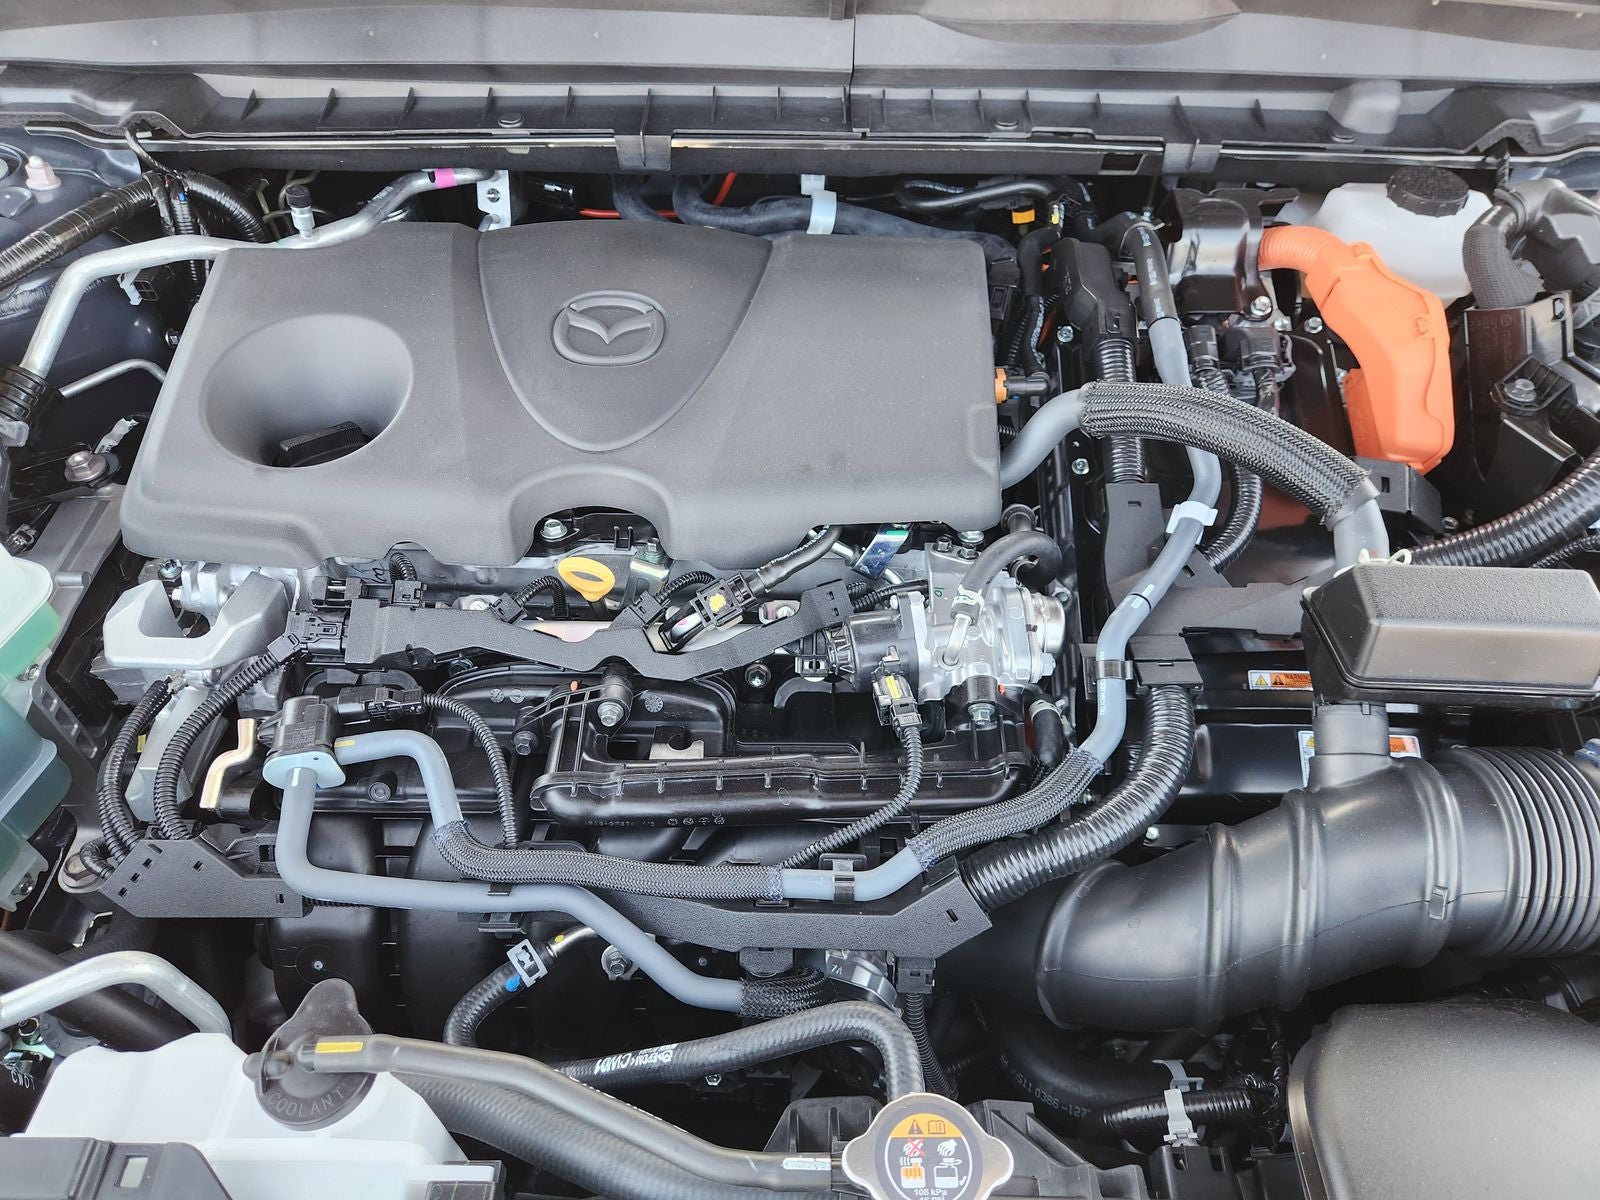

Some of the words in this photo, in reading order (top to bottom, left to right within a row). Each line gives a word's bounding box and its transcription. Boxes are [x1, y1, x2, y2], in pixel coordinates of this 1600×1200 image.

[267, 1085, 345, 1118] COOLANT
[913, 1188, 929, 1196] 108
[930, 1188, 947, 1196] kPa
